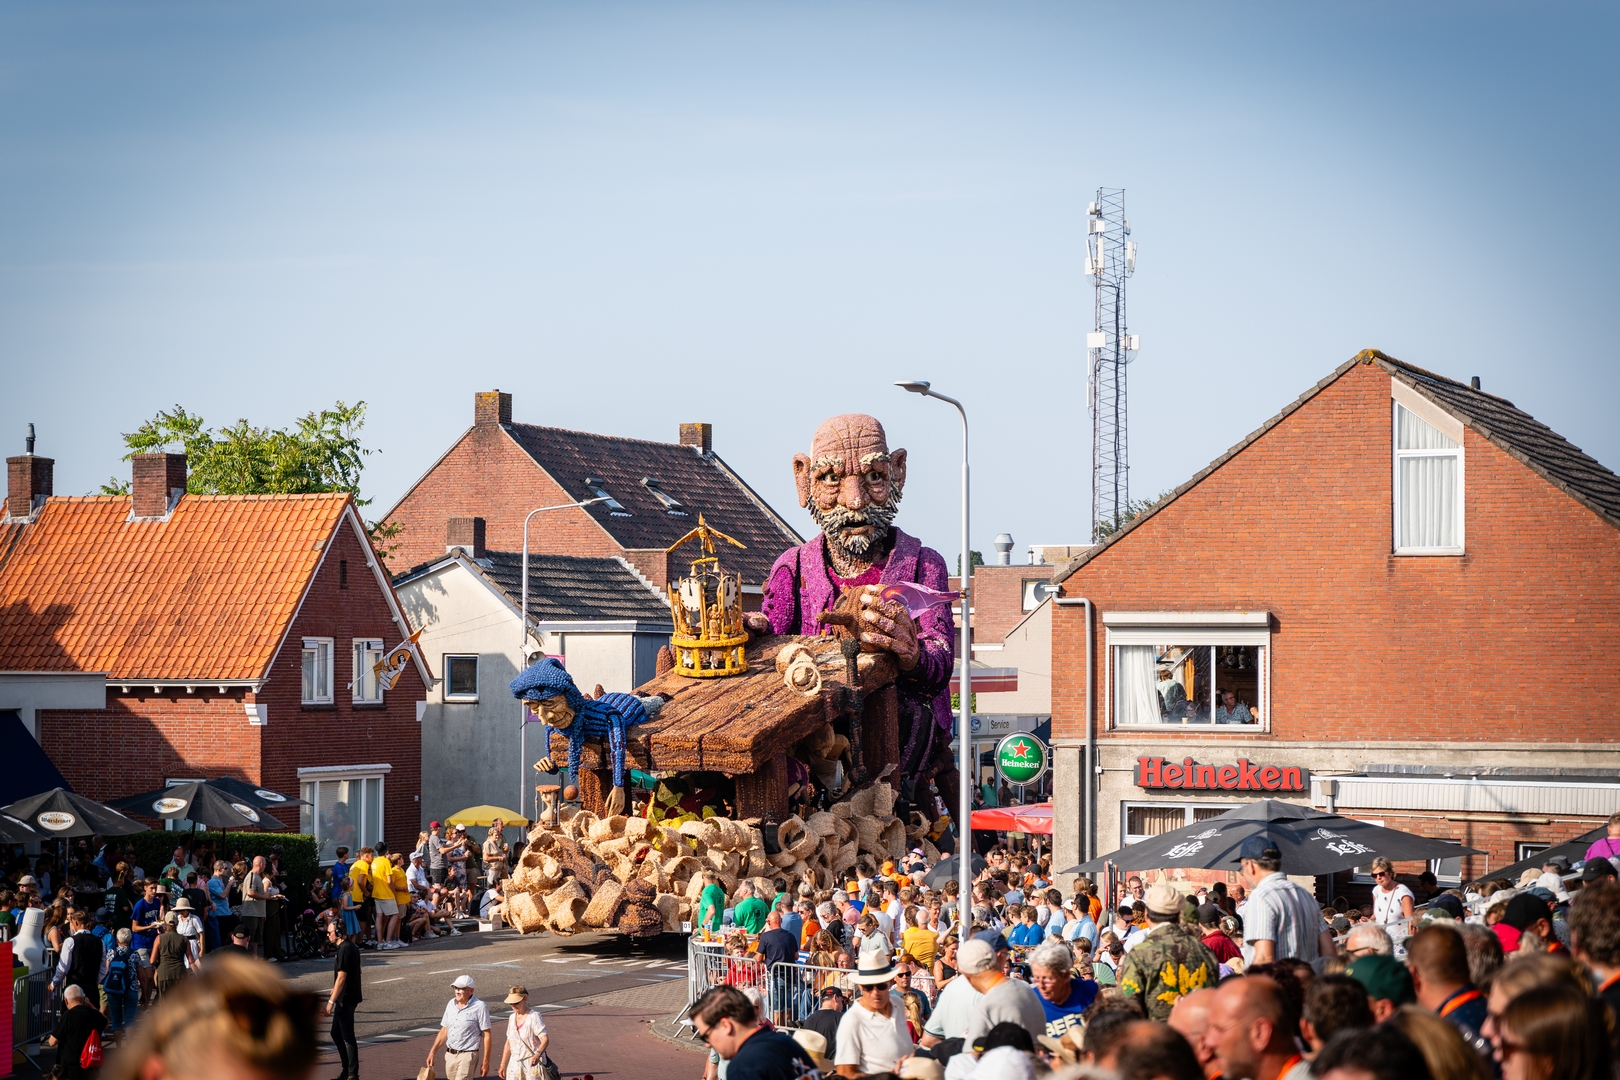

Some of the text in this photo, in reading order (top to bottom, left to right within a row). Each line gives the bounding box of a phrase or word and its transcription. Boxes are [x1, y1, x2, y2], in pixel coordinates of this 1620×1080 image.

[990, 719, 1010, 730] Service
[1001, 758, 1040, 769] Heineken
[1137, 757, 1304, 791] Heineken
